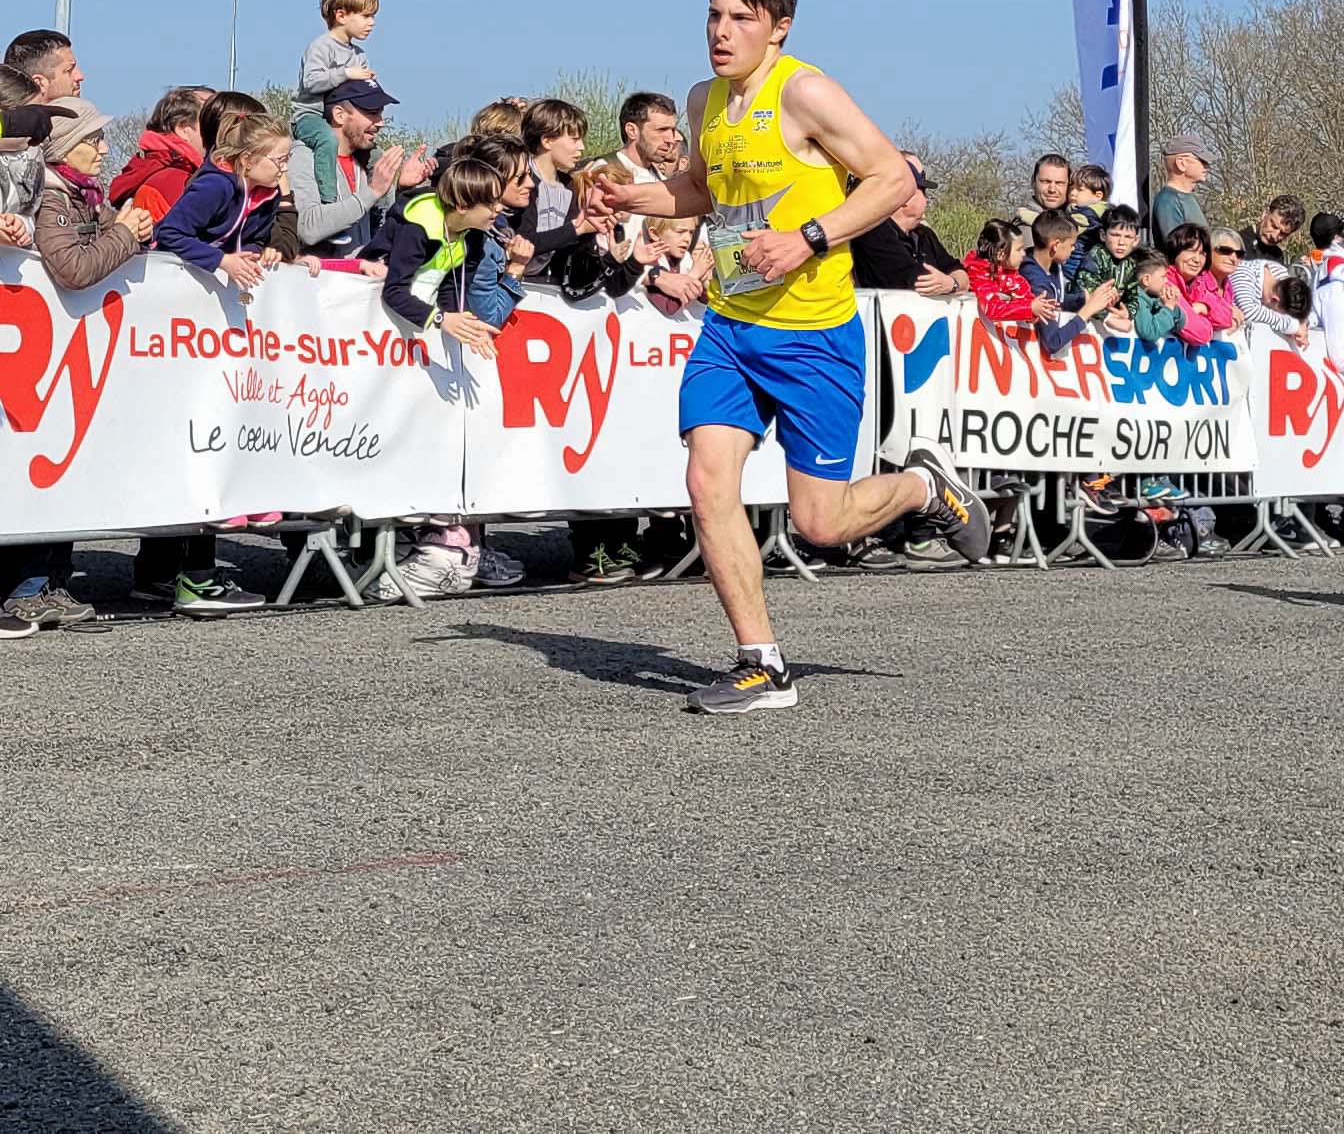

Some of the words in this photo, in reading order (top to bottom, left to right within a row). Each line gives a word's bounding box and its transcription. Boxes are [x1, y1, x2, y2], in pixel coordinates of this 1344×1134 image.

[129, 326, 165, 358] La
[170, 317, 431, 367] Roche-sur-Yon
[628, 341, 663, 367] La
[954, 314, 1238, 407] INTERSPORT
[222, 366, 265, 404] Ville
[268, 377, 284, 404] et
[285, 373, 349, 430] Agglo
[493, 308, 621, 474] Ry
[189, 418, 227, 454] Le
[286, 413, 383, 460] Vendée
[960, 408, 1095, 458] ROCHE
[1110, 416, 1172, 460] SUR
[1183, 418, 1231, 460] YON
